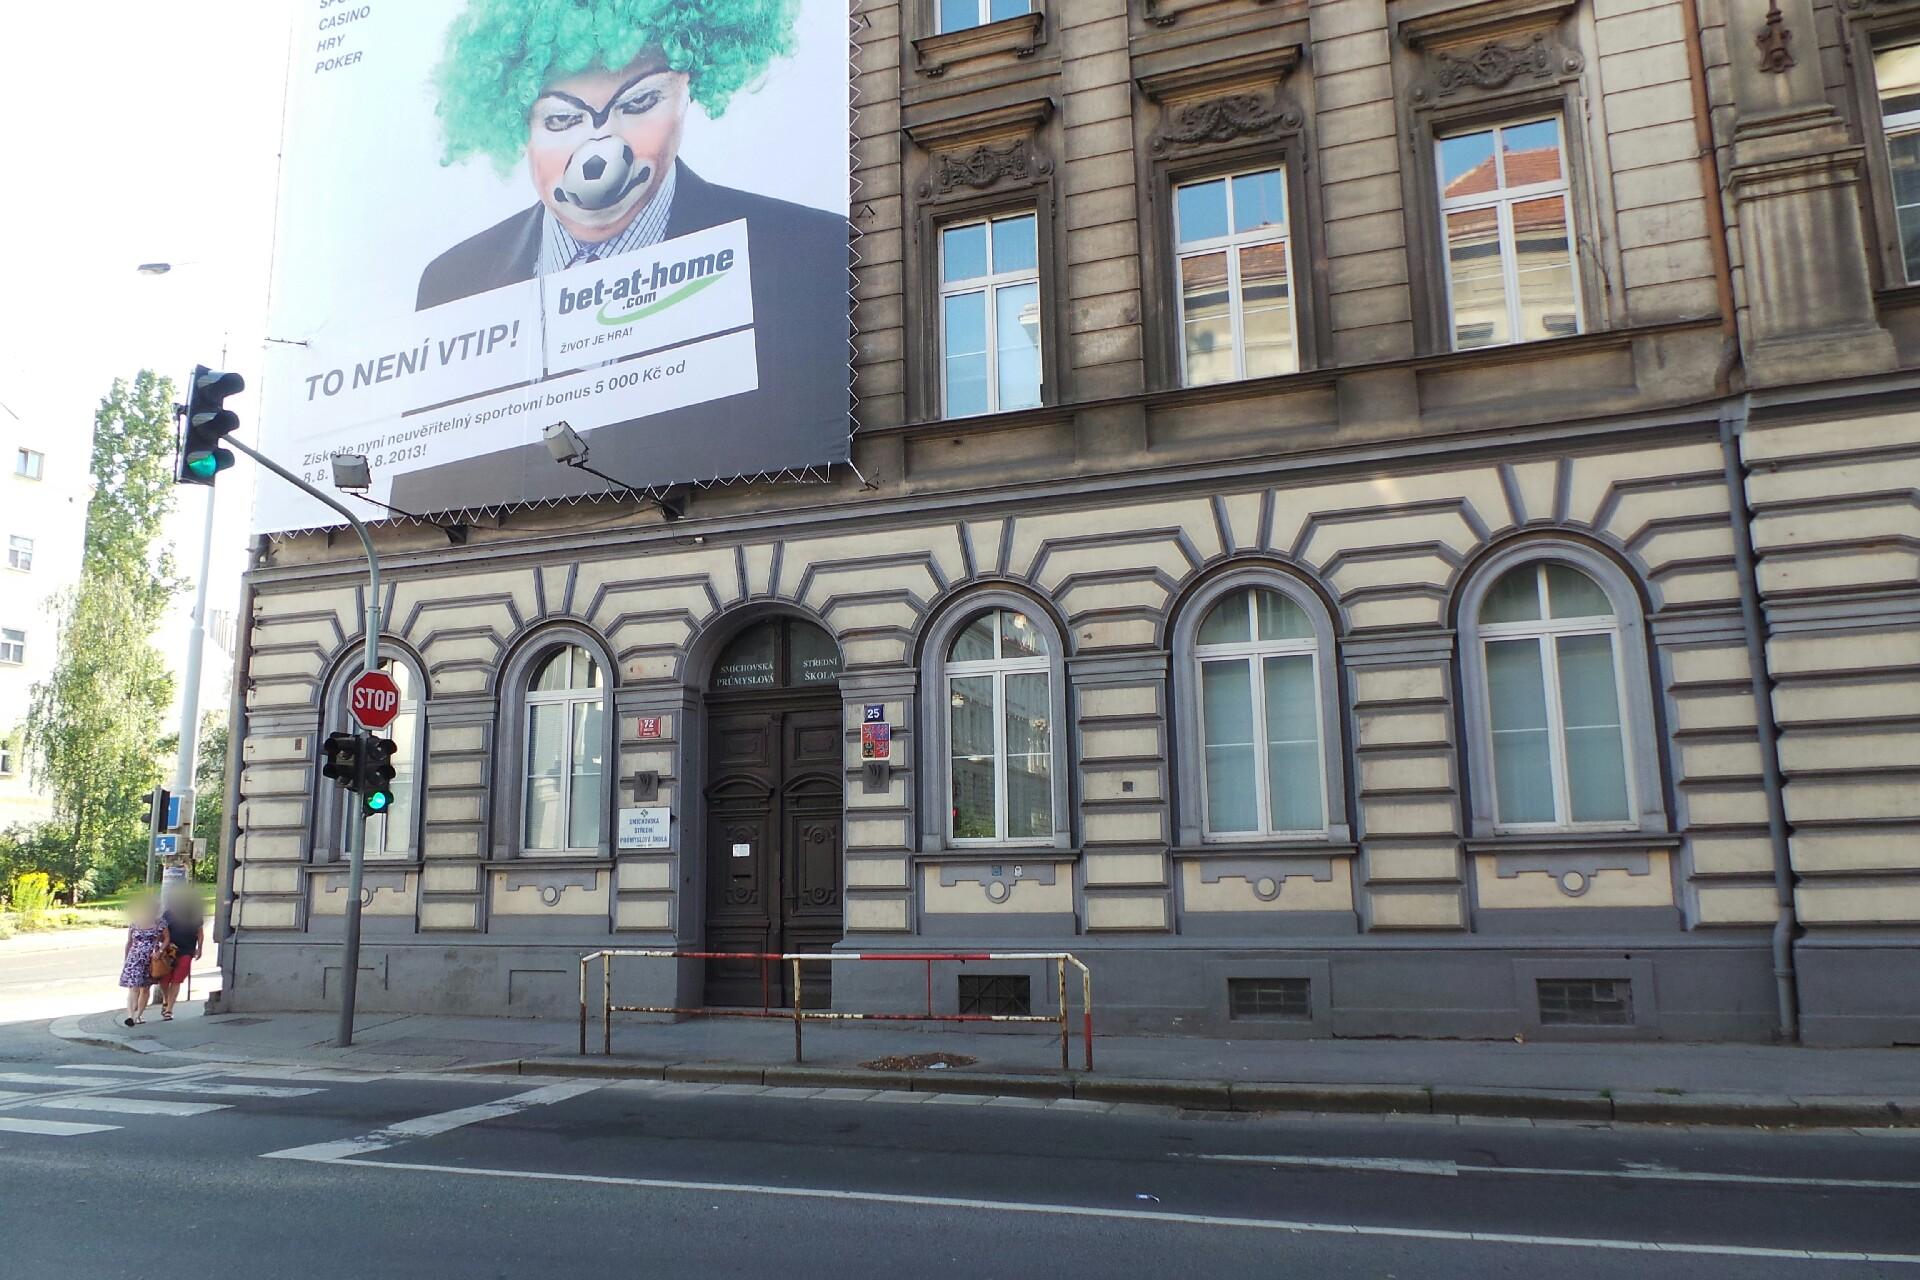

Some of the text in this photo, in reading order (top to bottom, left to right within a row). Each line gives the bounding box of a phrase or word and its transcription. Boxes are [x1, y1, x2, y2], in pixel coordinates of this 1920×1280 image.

[318, 5, 371, 31] CASINO
[316, 33, 346, 53] HRY
[314, 50, 363, 74] POKER
[558, 248, 734, 315] bet-at-home
[622, 291, 657, 310] .com
[560, 327, 633, 354] ŽIVOT JE HRA!
[305, 319, 520, 401] TO NENÍ VTIP!
[387, 413, 472, 445] neuvěřitelný
[474, 395, 543, 426] sportovní
[545, 384, 591, 407] bonus
[594, 380, 604, 394] 5
[608, 372, 639, 391] 000
[642, 366, 662, 383] Kč
[665, 360, 686, 377] od
[720, 656, 838, 674] SMÍCHOVSKÁ STŘEDNÍ
[716, 670, 836, 687] PRŮMYSLOVÁ ŠKOLA
[354, 687, 396, 712] STOP
[644, 719, 654, 728] 72
[867, 708, 880, 719] 25
[160, 839, 167, 851] 5
